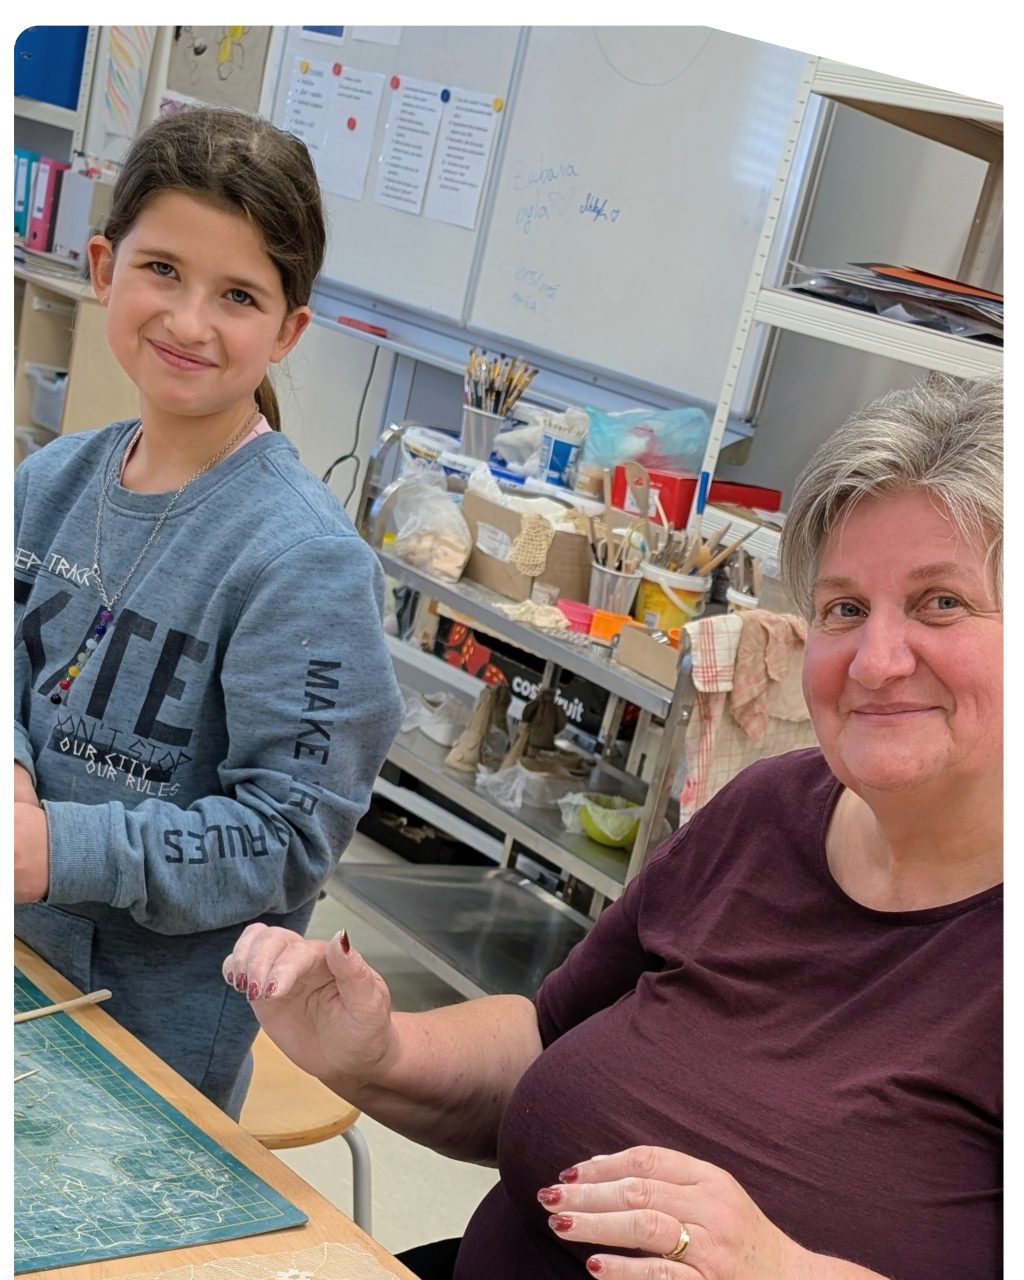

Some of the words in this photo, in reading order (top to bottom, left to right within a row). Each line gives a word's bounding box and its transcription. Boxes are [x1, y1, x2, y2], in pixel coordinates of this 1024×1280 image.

[293, 659, 342, 765] MAKE
[59, 737, 98, 761] OUR
[104, 752, 152, 780] CITY
[128, 738, 193, 774] STOP
[85, 760, 118, 781] OUR
[126, 773, 181, 797] RULES
[163, 824, 270, 865] RULES
